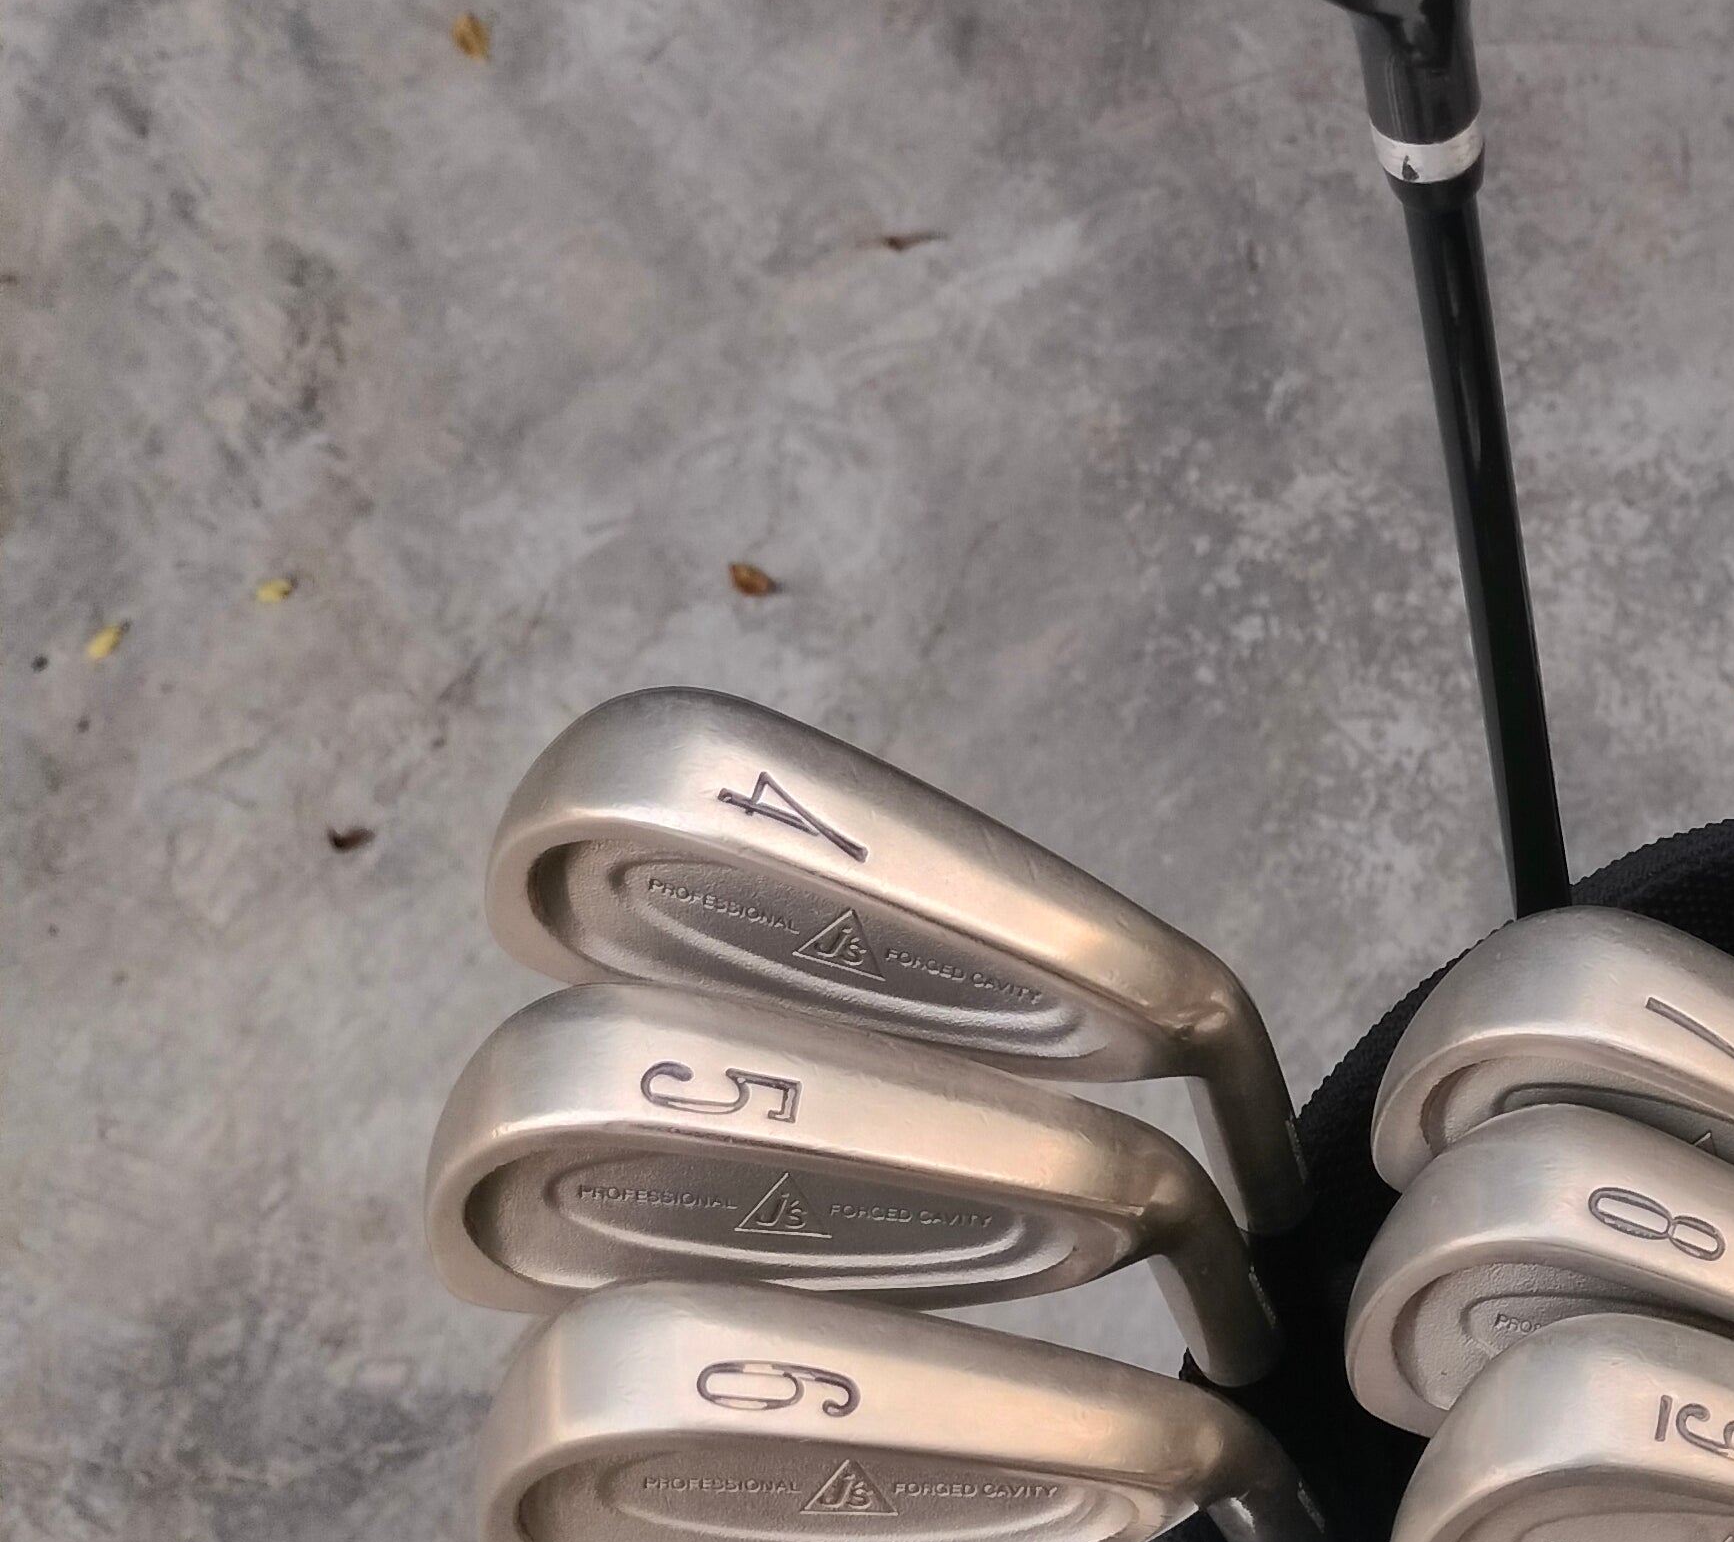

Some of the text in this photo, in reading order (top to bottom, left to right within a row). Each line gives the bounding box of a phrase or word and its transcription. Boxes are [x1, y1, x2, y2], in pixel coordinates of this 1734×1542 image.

[718, 771, 869, 862] 4
[648, 877, 800, 935] PROFESSIONAL
[885, 947, 1043, 1006] FORGED CAVITY
[641, 1061, 803, 1125] 5
[576, 1184, 739, 1211] PROFESSIONAL
[828, 1203, 912, 1224] FORGED
[1587, 1185, 1726, 1262] 8
[695, 1359, 862, 1418] 6
[642, 1476, 801, 1495] PROFESSIONAL
[893, 1481, 1059, 1500] FORGED CAVITY
